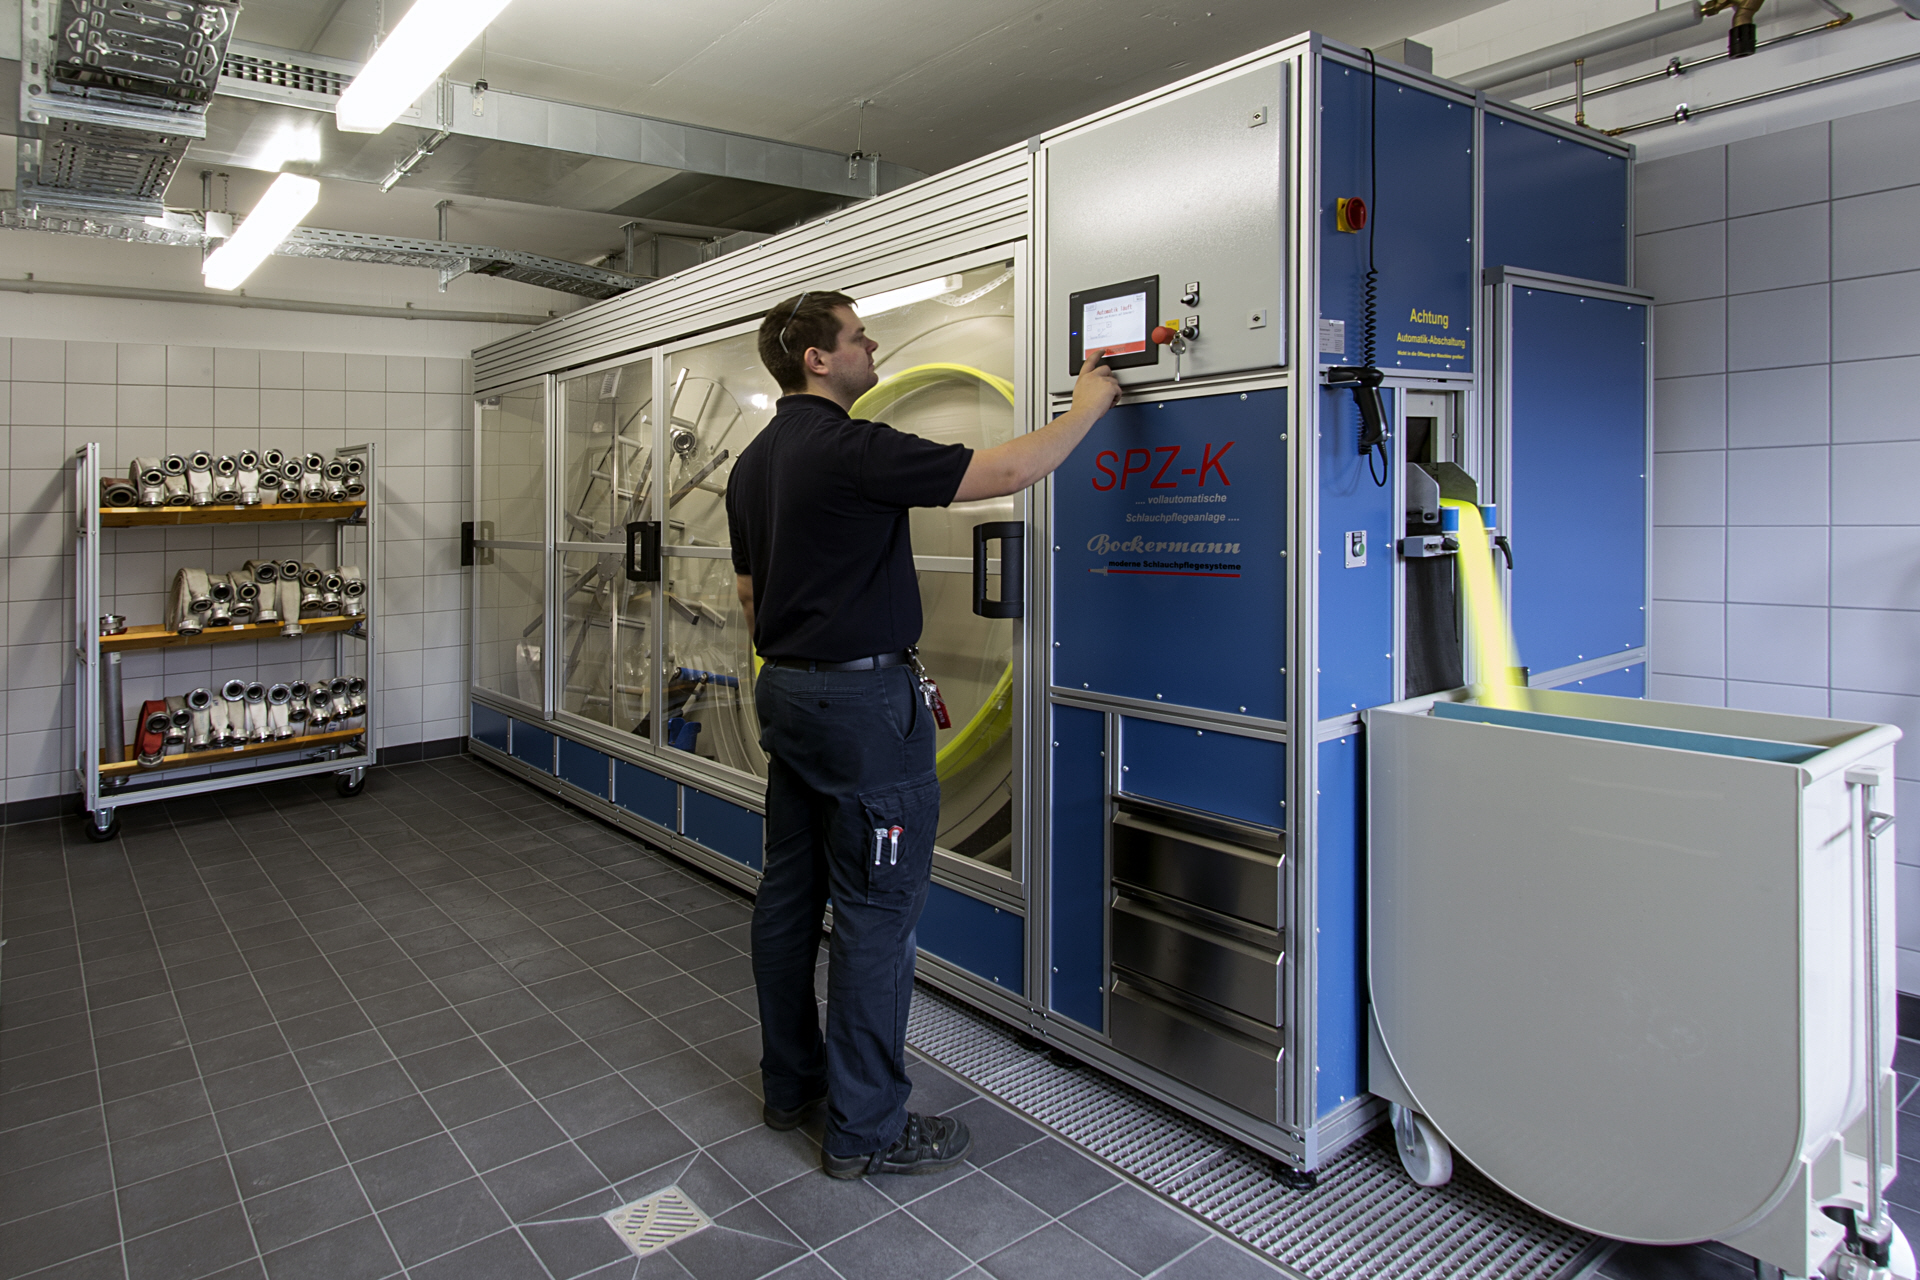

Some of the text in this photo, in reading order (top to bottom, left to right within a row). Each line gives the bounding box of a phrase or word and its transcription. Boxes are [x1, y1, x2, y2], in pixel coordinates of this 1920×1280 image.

[1410, 308, 1449, 329] Achtung
[1396, 332, 1466, 349] Automatik-Abschaltung
[1091, 441, 1236, 492] SPZ-K
[1148, 493, 1228, 505] vollautomatische
[1125, 512, 1226, 524] Schlauchpflegeanlage
[1086, 533, 1241, 556] Bockermann
[1108, 559, 1242, 571] moderne Schlauchpflegesysteme
